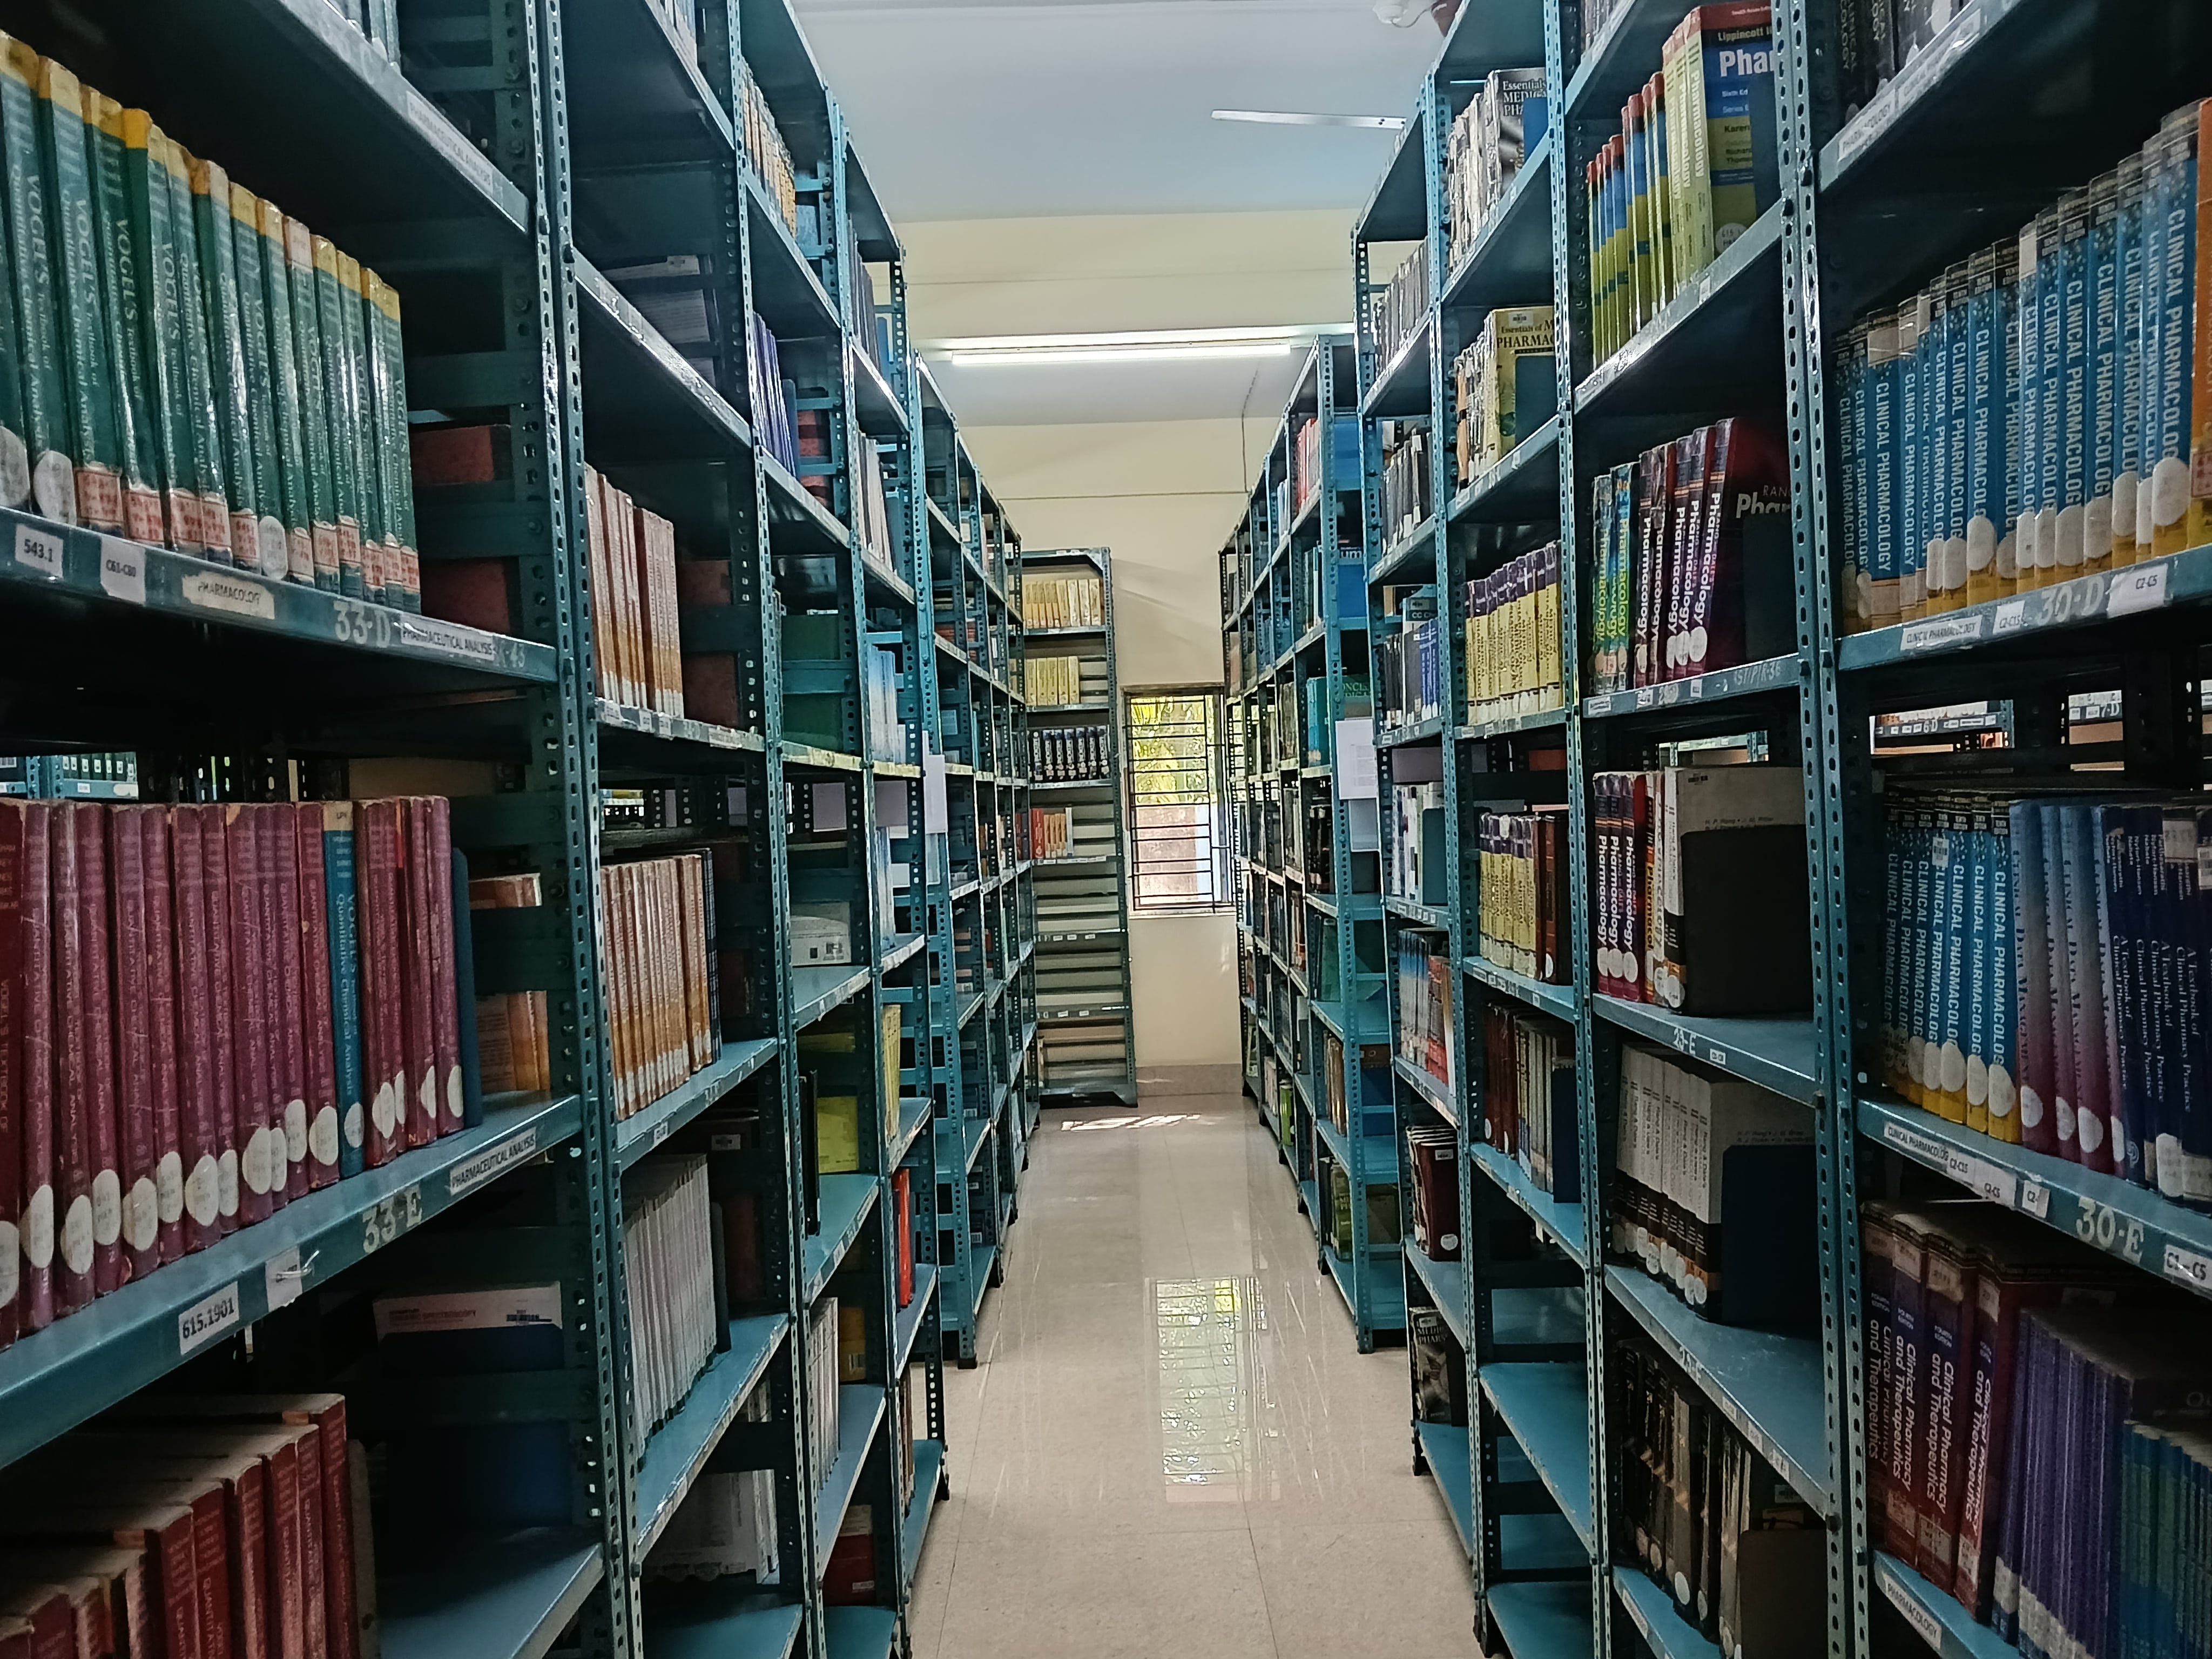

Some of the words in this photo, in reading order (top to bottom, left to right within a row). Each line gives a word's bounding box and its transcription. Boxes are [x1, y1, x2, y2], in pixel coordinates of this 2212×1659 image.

[1717, 26, 1764, 42] Lippincott
[1691, 69, 1704, 178] Pharmacology
[27, 174, 50, 285] VOGEL'S
[76, 200, 97, 303] VOGEL'S
[116, 219, 138, 321] VOGEL'S
[2165, 208, 2186, 305] CLINICAL
[162, 242, 181, 341] VOGEL'S
[2044, 293, 2059, 375] CLINICAL
[2066, 280, 2083, 364] CLINICAL
[2096, 263, 2114, 350] CLINICAL
[2124, 247, 2142, 336] CLINICAL
[1934, 351, 1947, 423] CLINICAL
[1952, 341, 1966, 416] CLINICAL
[1974, 329, 1990, 405] CLINICAL
[2024, 305, 2039, 386] CLINICAL
[2162, 305, 2184, 458] PHARMACOLOG
[1839, 397, 1852, 462] CLINICAL
[1854, 389, 1866, 455] CLINICAL
[1876, 382, 1890, 450] CLINICAL
[1904, 373, 1916, 442] CLINICAL
[2065, 366, 2083, 507] PHARMACOLOG
[2095, 352, 2114, 498] PHARMACOLOG
[2122, 339, 2140, 471] PHARMACOLO
[2144, 323, 2159, 473] PHARMACOLOG
[1763, 485, 1791, 497] RAN
[1904, 444, 1916, 567] PHARMACOLOGY
[1933, 426, 1945, 541] PHARMACOLOG
[1950, 418, 1965, 539] PHARMACOLOG
[1973, 408, 1989, 517] PHARMACOLO
[2005, 402, 2020, 534] PHARMACOLOG
[24, 539, 53, 563] 543.1
[1841, 463, 1855, 569] PHARMACOLO
[1857, 457, 1870, 570] PHARMACOLOG
[1876, 451, 1892, 572] PHARMACOLOGY
[1618, 518, 1629, 636] Pharmacology
[1637, 517, 1651, 639] Pharmacology
[1667, 507, 1686, 635] Pharmacology
[1678, 500, 1700, 631] Pharmacology
[1693, 493, 1721, 625] Pharmacology
[2036, 574, 2106, 626] 30-D
[335, 893, 348, 974] Quantitative
[347, 894, 358, 973] VOGEL'S
[1597, 835, 1608, 946] Pharmacology
[1608, 835, 1621, 948] Pharmacology
[1623, 836, 1635, 950] Pharmacology
[1646, 864, 1655, 949] Pharmacol
[1901, 860, 1913, 922] CLINICAL
[1917, 860, 1929, 925] CLINICAL
[1951, 865, 1965, 932] CLINICAL
[1973, 865, 1985, 934] CLINICAL
[1994, 872, 2006, 942] CLINICAL
[341, 979, 352, 1040] Chemical
[1913, 928, 1927, 1036] PHARMACOLOG
[1928, 930, 1943, 1043] PHARMACOLOG
[1947, 936, 1962, 1046] PHARMACOLO
[1971, 938, 1984, 1056] PHARMACOLOG
[1993, 946, 2006, 1065] PHARMACOLOG
[2176, 946, 2187, 995] Clinical
[344, 1043, 354, 1096] Analysis
[451, 1149, 509, 1188] PHARMACEUTICAL
[507, 1135, 536, 1157] ANALYSIS
[1887, 1127, 1908, 1146] CLINICAL
[1908, 1135, 1950, 1162] PHARMACOLOG
[1950, 1157, 1969, 1174] C2-C15
[361, 1187, 423, 1254] 33-E
[1984, 1182, 2001, 1198] C2-C5
[2076, 1197, 2145, 1264] 30-E
[181, 1297, 235, 1339] 615.1901
[1870, 1319, 1882, 1353] and
[1896, 1335, 1906, 1371] and
[1868, 1357, 1882, 1460] Therapeutics
[1906, 1343, 1917, 1405] Clinical
[1931, 1353, 1943, 1390] and
[1942, 1360, 1954, 1425] Clinical
[1974, 1370, 1985, 1408] and
[1892, 1374, 1906, 1480] Therapeutics
[1900, 1406, 1915, 1492] Pharmacy
[1925, 1393, 1943, 1501] Therapeutics
[1936, 1426, 1952, 1514] Pharmacy
[1965, 1411, 1982, 1523] Therapeutics
[1886, 1583, 1938, 1640] PHARMACOLOGY
